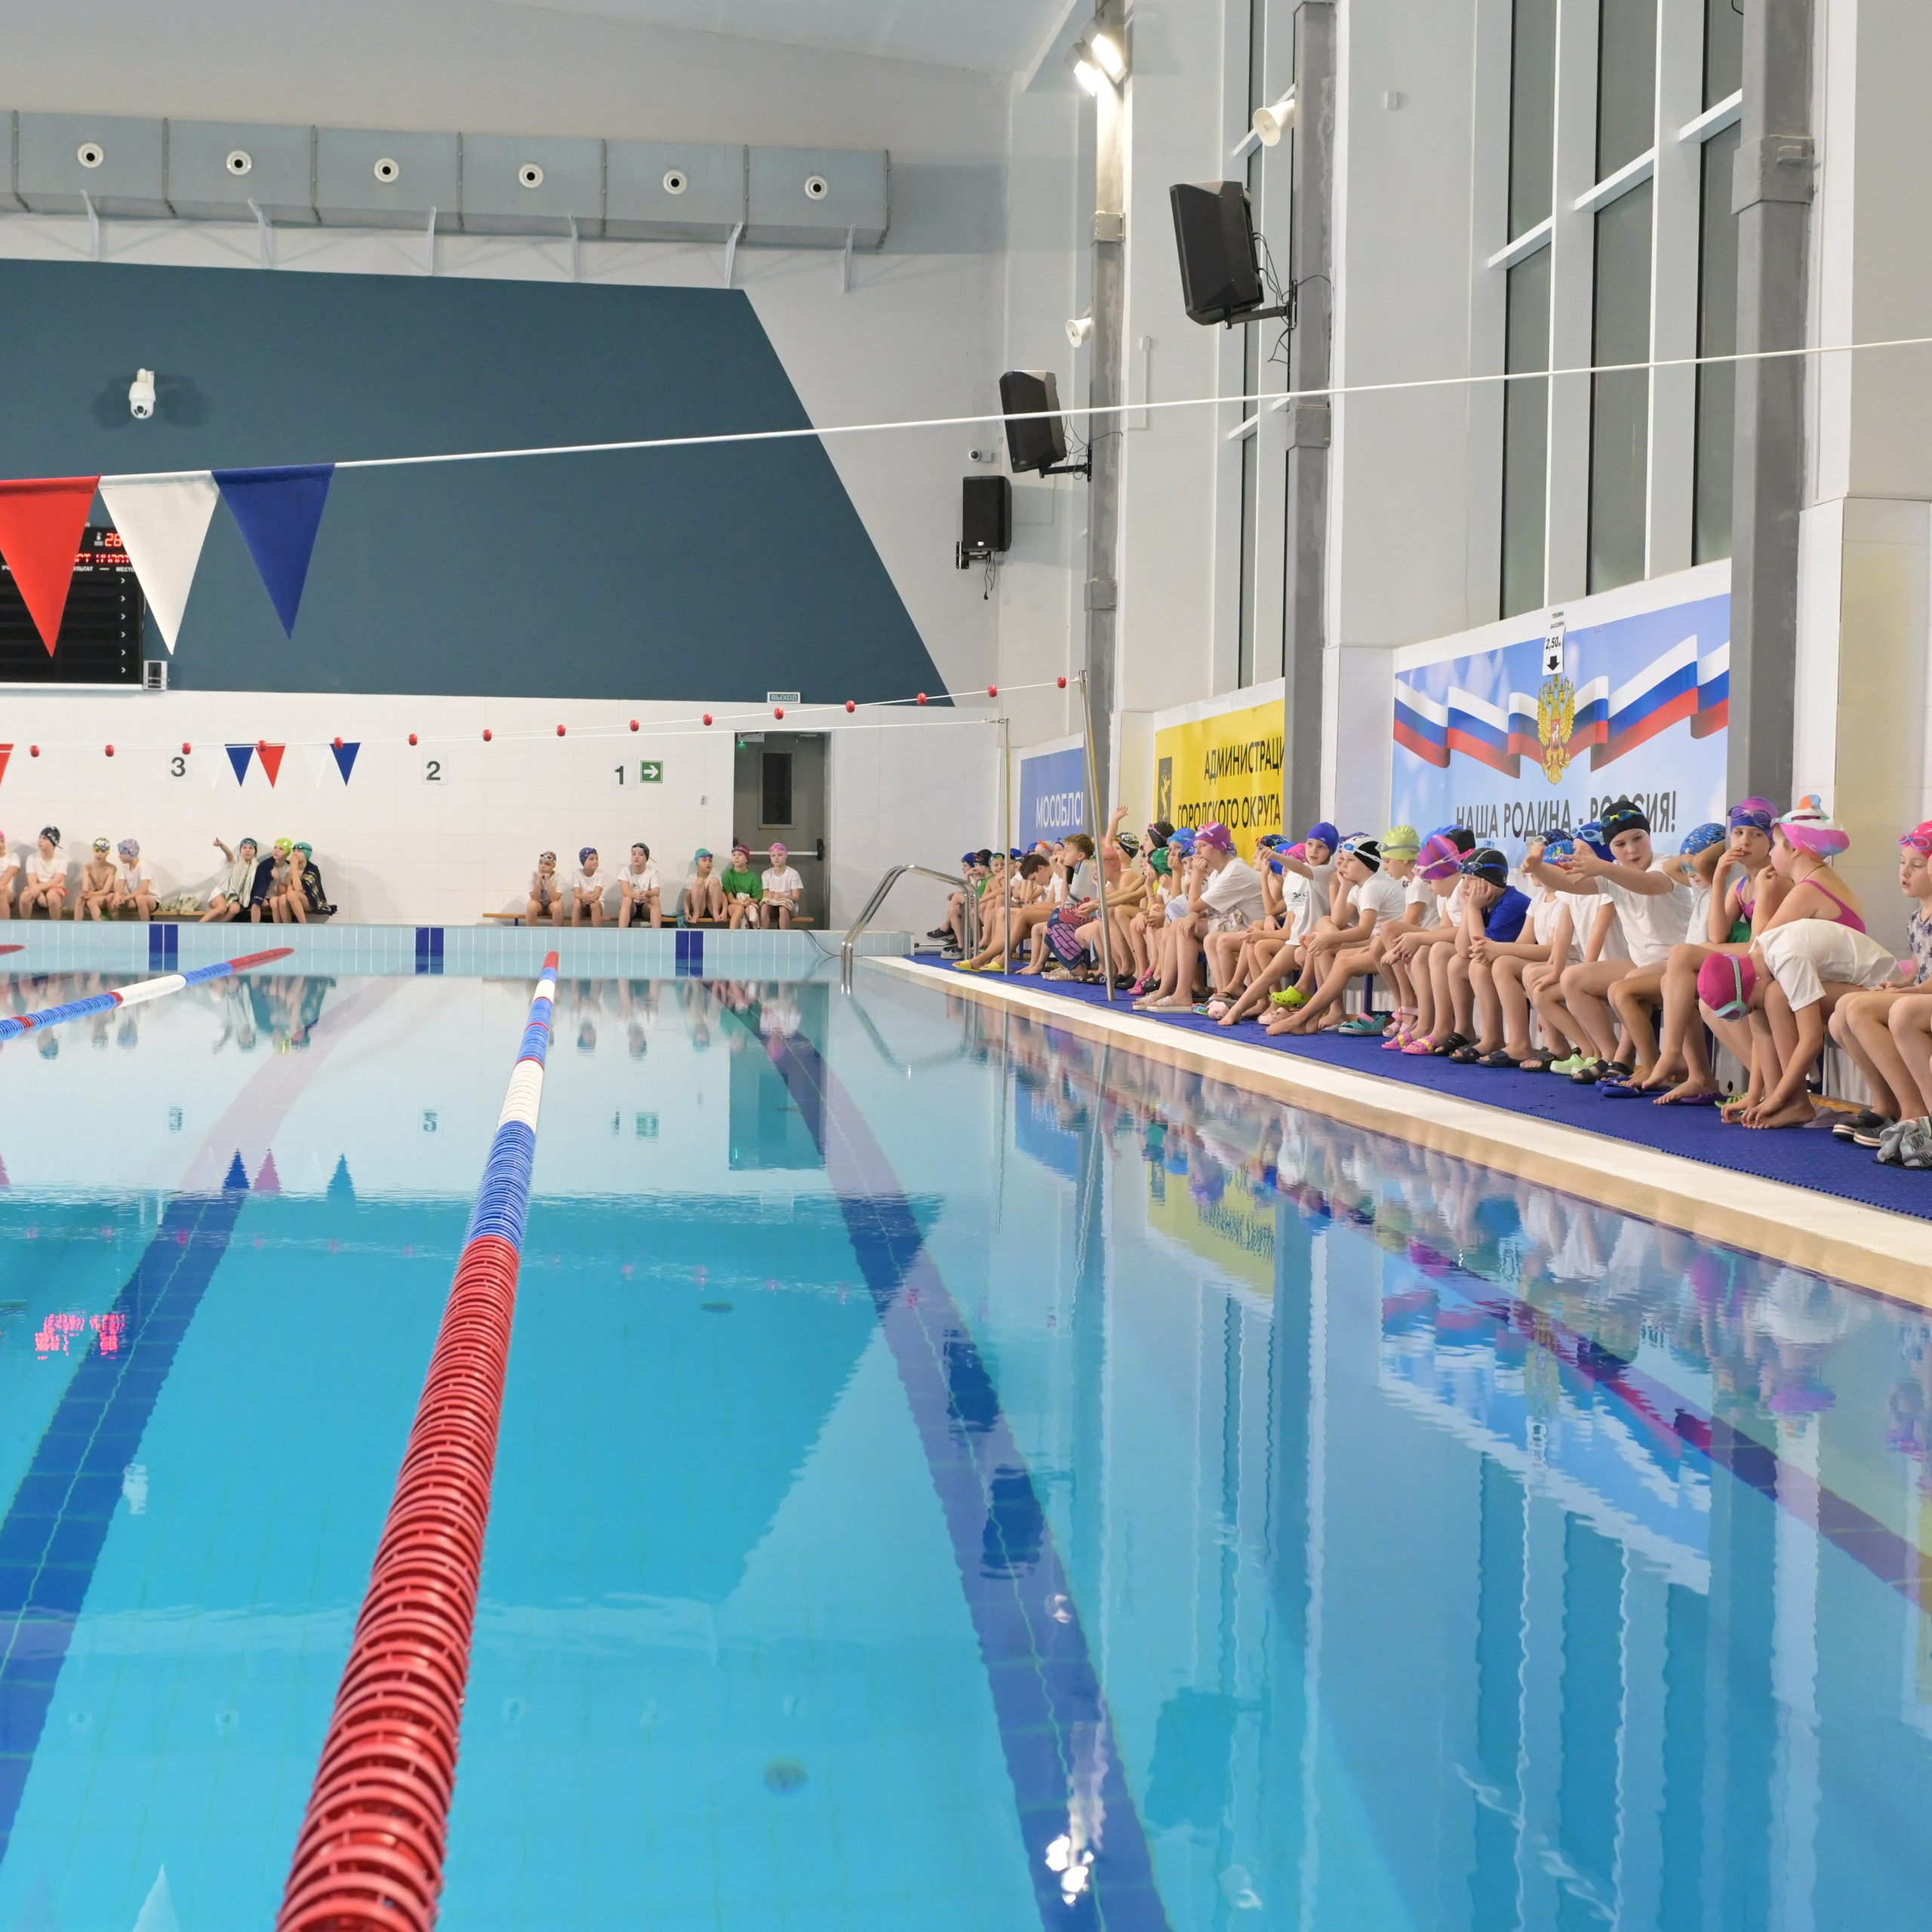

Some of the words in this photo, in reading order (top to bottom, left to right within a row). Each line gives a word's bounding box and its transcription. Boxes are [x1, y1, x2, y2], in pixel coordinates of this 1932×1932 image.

[171, 756, 186, 777] 3
[426, 761, 441, 780] 2
[614, 765, 623, 785] 1
[1036, 791, 1083, 829] МОСОБЛС
[1178, 798, 1239, 830] ГОРОДСКОГО
[1241, 792, 1281, 829] ОКРУГА
[1457, 804, 1498, 838] НАША
[1503, 798, 1571, 842] РОДИНА
